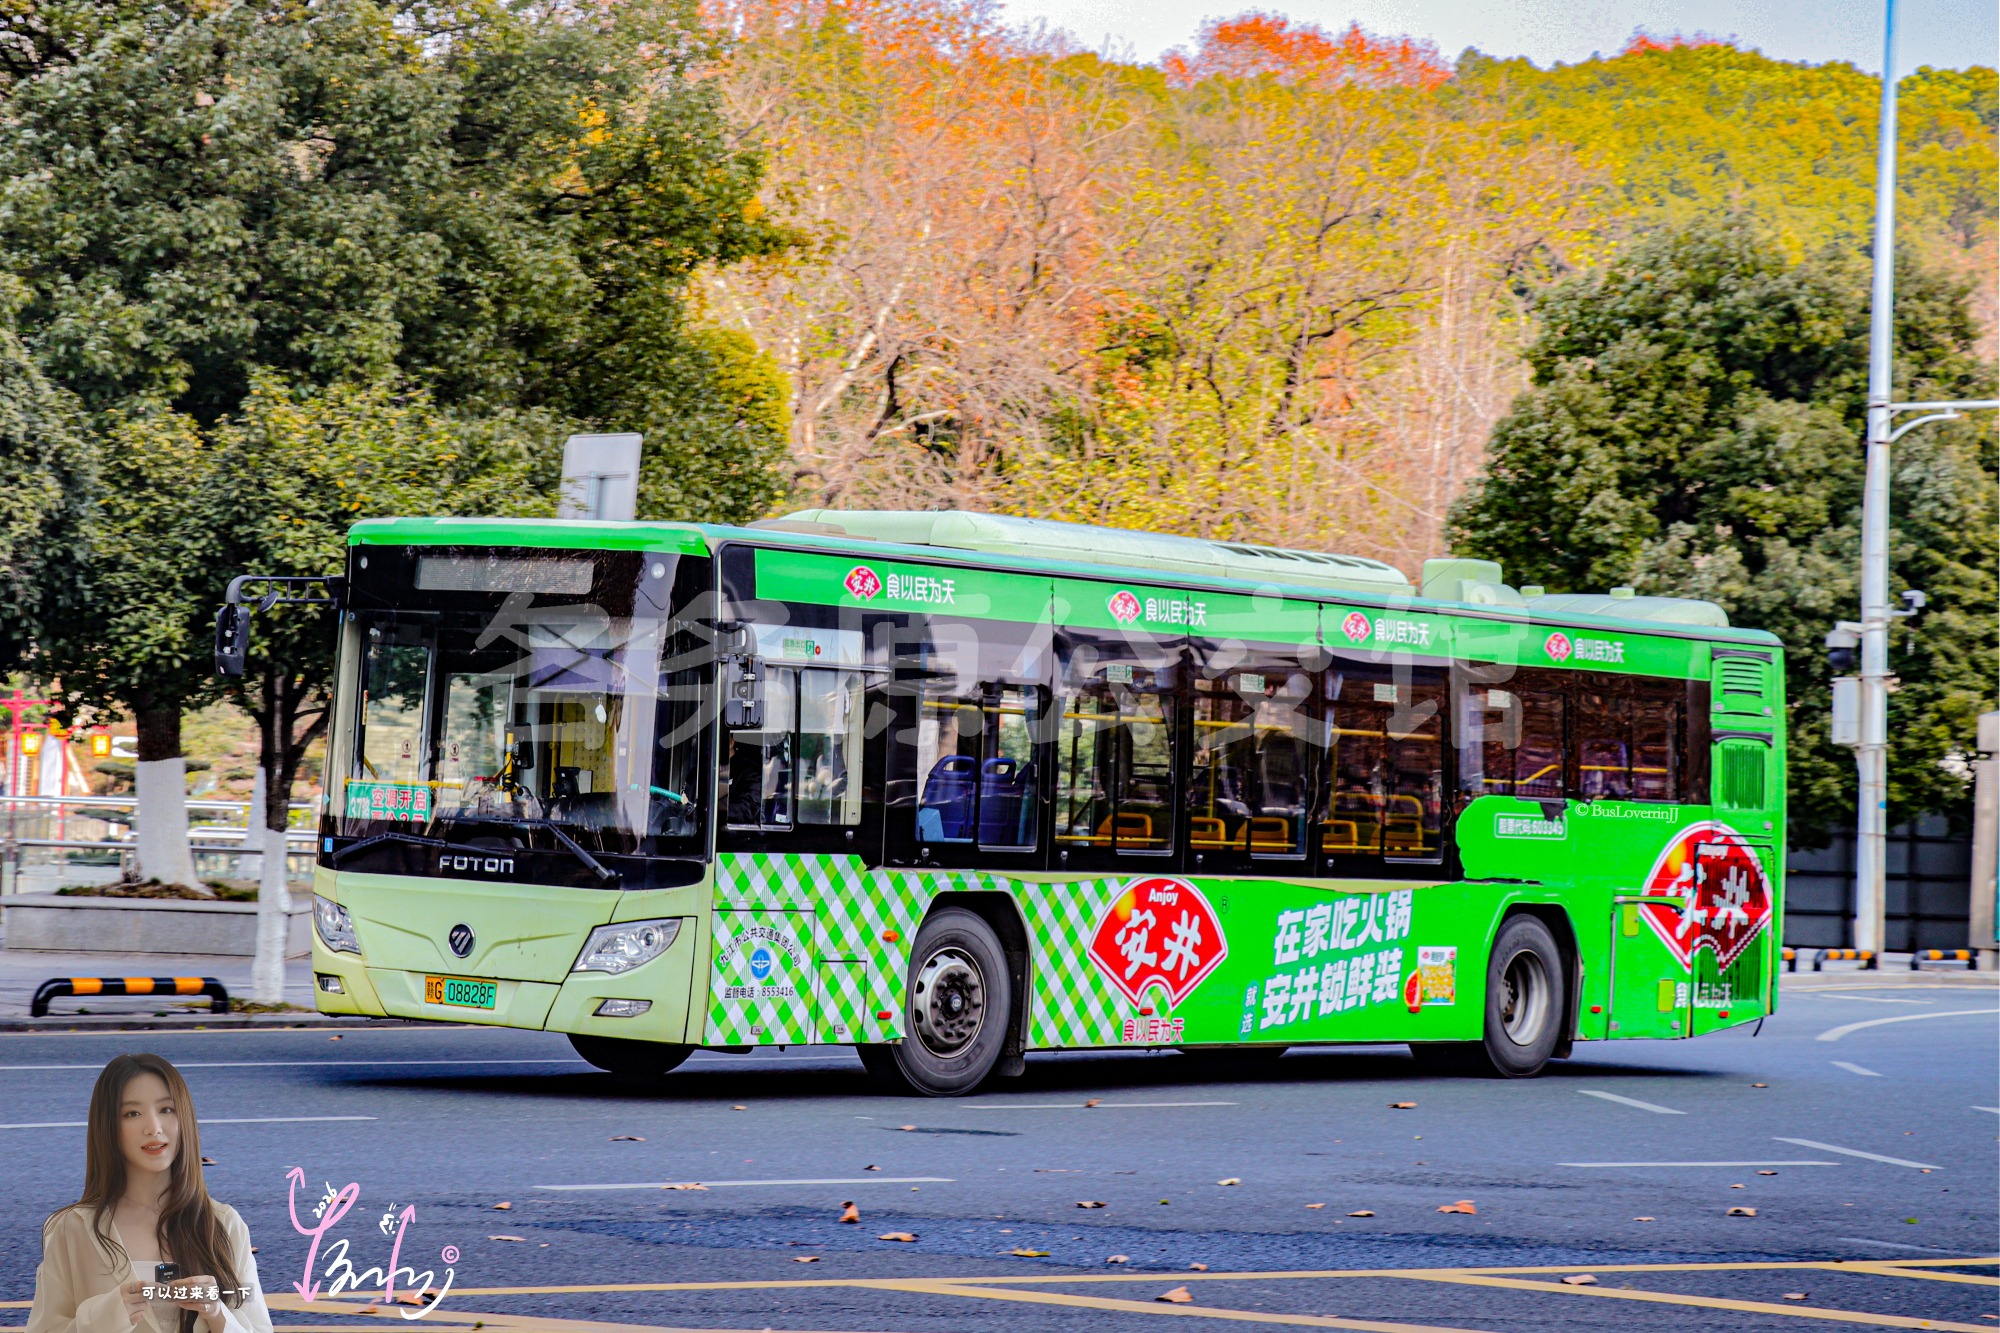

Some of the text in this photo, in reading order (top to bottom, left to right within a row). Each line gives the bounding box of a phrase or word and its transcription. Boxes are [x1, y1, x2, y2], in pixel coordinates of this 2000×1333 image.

[887, 573, 955, 604] 食以民为天
[1145, 597, 1207, 627] 食以民为天
[1375, 618, 1430, 646] 食以民为天
[1574, 637, 1625, 664] 食以民为天
[371, 788, 427, 810] 空调开启
[439, 855, 514, 873] FOTON
[1149, 884, 1178, 906] Anjoy
[1274, 889, 1413, 966] 在家吃火锅
[719, 927, 801, 967] 九江市公共交通集团公司
[1114, 909, 1202, 981] 安井
[1260, 947, 1403, 1030] 安井锁鲜装
[1123, 1018, 1185, 1042] 食以民为天
